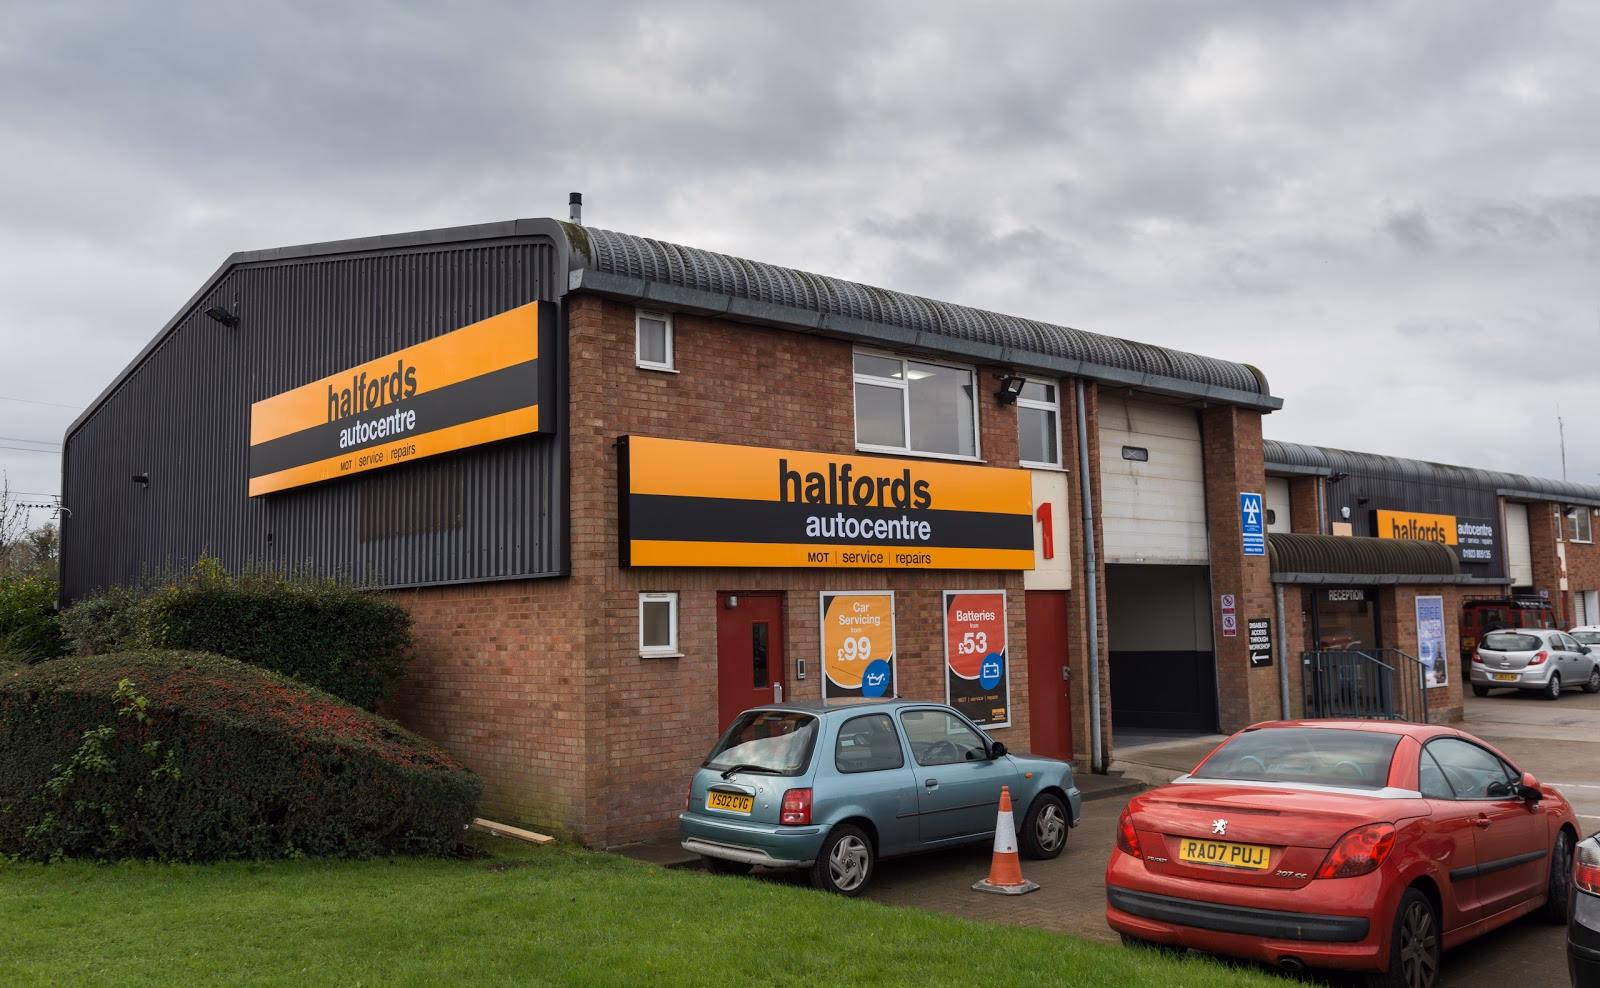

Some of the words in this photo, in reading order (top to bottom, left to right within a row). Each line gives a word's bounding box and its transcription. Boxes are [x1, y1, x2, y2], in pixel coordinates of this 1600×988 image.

[328, 359, 417, 423] halfords
[339, 408, 416, 449] autocentre
[340, 460, 352, 471] MOT
[358, 451, 384, 467] service
[390, 443, 416, 461] repairs
[779, 458, 932, 510] halfords
[805, 512, 931, 541] autocentre
[1036, 502, 1054, 559] 1
[1391, 517, 1446, 545] halfords
[1457, 522, 1492, 537] autocentre
[808, 552, 829, 563] MOT
[842, 550, 884, 564] service
[895, 551, 932, 567] repairs
[1328, 589, 1364, 601] RECEPTION
[853, 602, 870, 613] Car
[956, 609, 996, 622] Batteries
[1419, 606, 1440, 620] FREE
[838, 614, 881, 626] Servicing
[1248, 621, 1268, 629] DISABLED
[837, 636, 871, 661] £99
[958, 631, 988, 655] £53
[1248, 643, 1271, 651] WORKSHOP
[712, 793, 732, 807] YS02
[732, 797, 749, 809] CVG
[1187, 842, 1227, 861] RA07
[1230, 846, 1264, 865] PUJ
